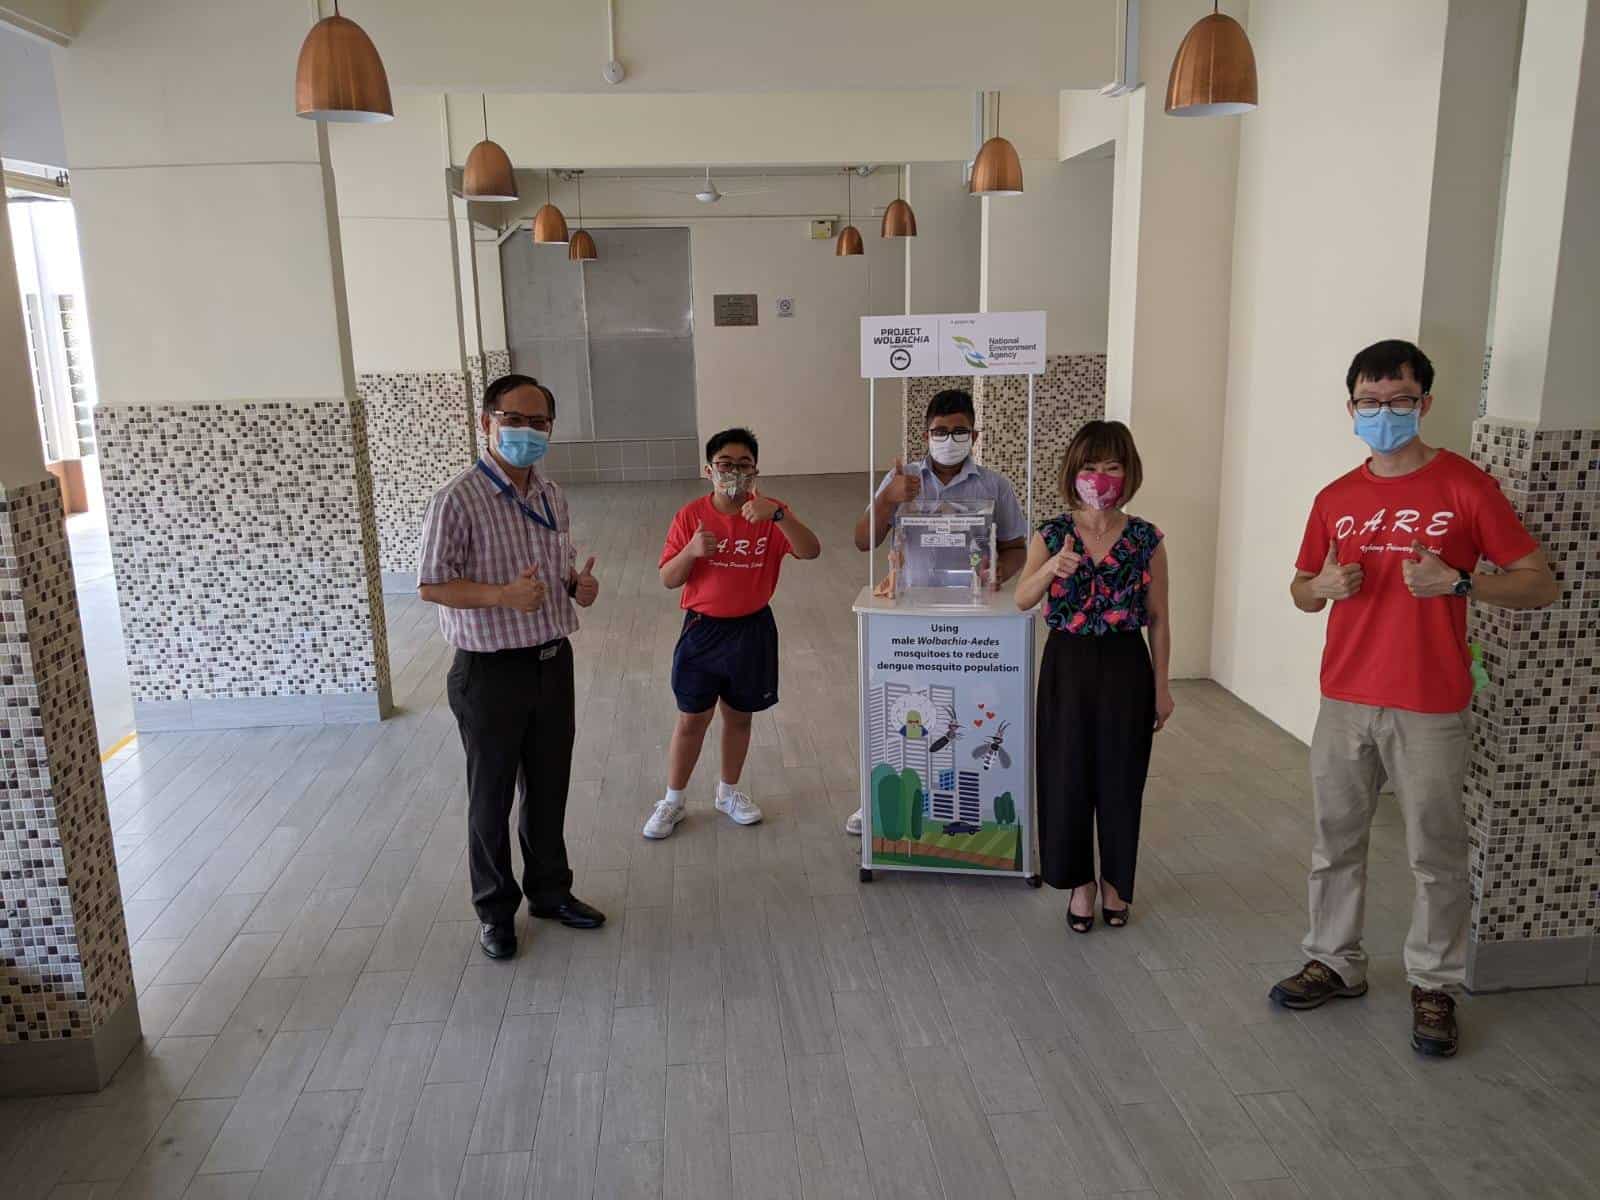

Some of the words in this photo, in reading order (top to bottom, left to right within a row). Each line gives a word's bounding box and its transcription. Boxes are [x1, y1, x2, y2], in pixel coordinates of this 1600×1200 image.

[880, 327, 922, 336] PROJECT
[873, 335, 930, 345] WOLBACHIA
[988, 337, 1019, 345] National
[988, 343, 1037, 351] Environment
[988, 351, 1018, 360] Agency
[931, 623, 959, 635] Using
[891, 636, 915, 645] male
[917, 636, 1000, 646] Wolbachia-Aedes
[894, 650, 950, 660] mosquitoes
[952, 650, 963, 659] to
[965, 650, 1000, 659] reduce
[876, 662, 914, 673] dengue
[915, 662, 962, 674] mosquito
[963, 663, 1020, 674] population
